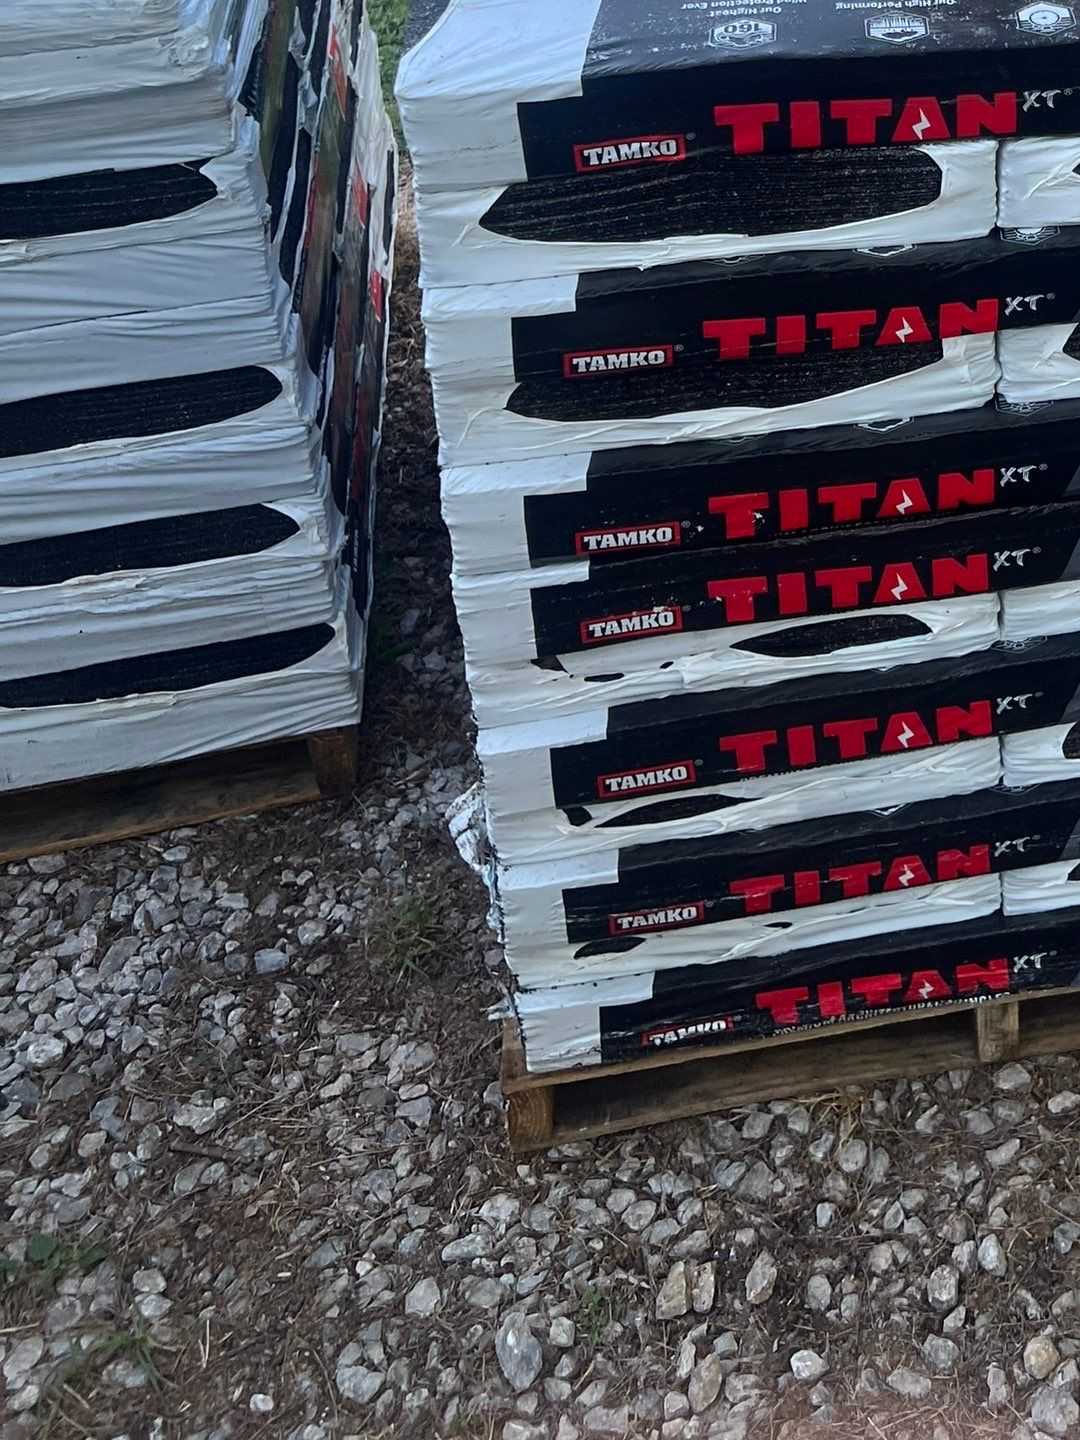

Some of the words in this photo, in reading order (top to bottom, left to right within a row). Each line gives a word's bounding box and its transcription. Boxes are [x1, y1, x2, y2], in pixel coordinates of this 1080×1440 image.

[681, 2, 708, 11] Ever
[709, 6, 758, 17] Highest
[724, 22, 762, 34] 160
[760, 6, 782, 14] Our
[835, 0, 903, 10] Performing
[713, 92, 1018, 156] TITAN
[702, 299, 999, 361] TITAN
[708, 469, 995, 540] TITAN
[707, 554, 988, 624] TITAN
[719, 700, 993, 775] TITAN
[730, 844, 991, 913] TITAN
[756, 958, 1010, 1025] TITAN
